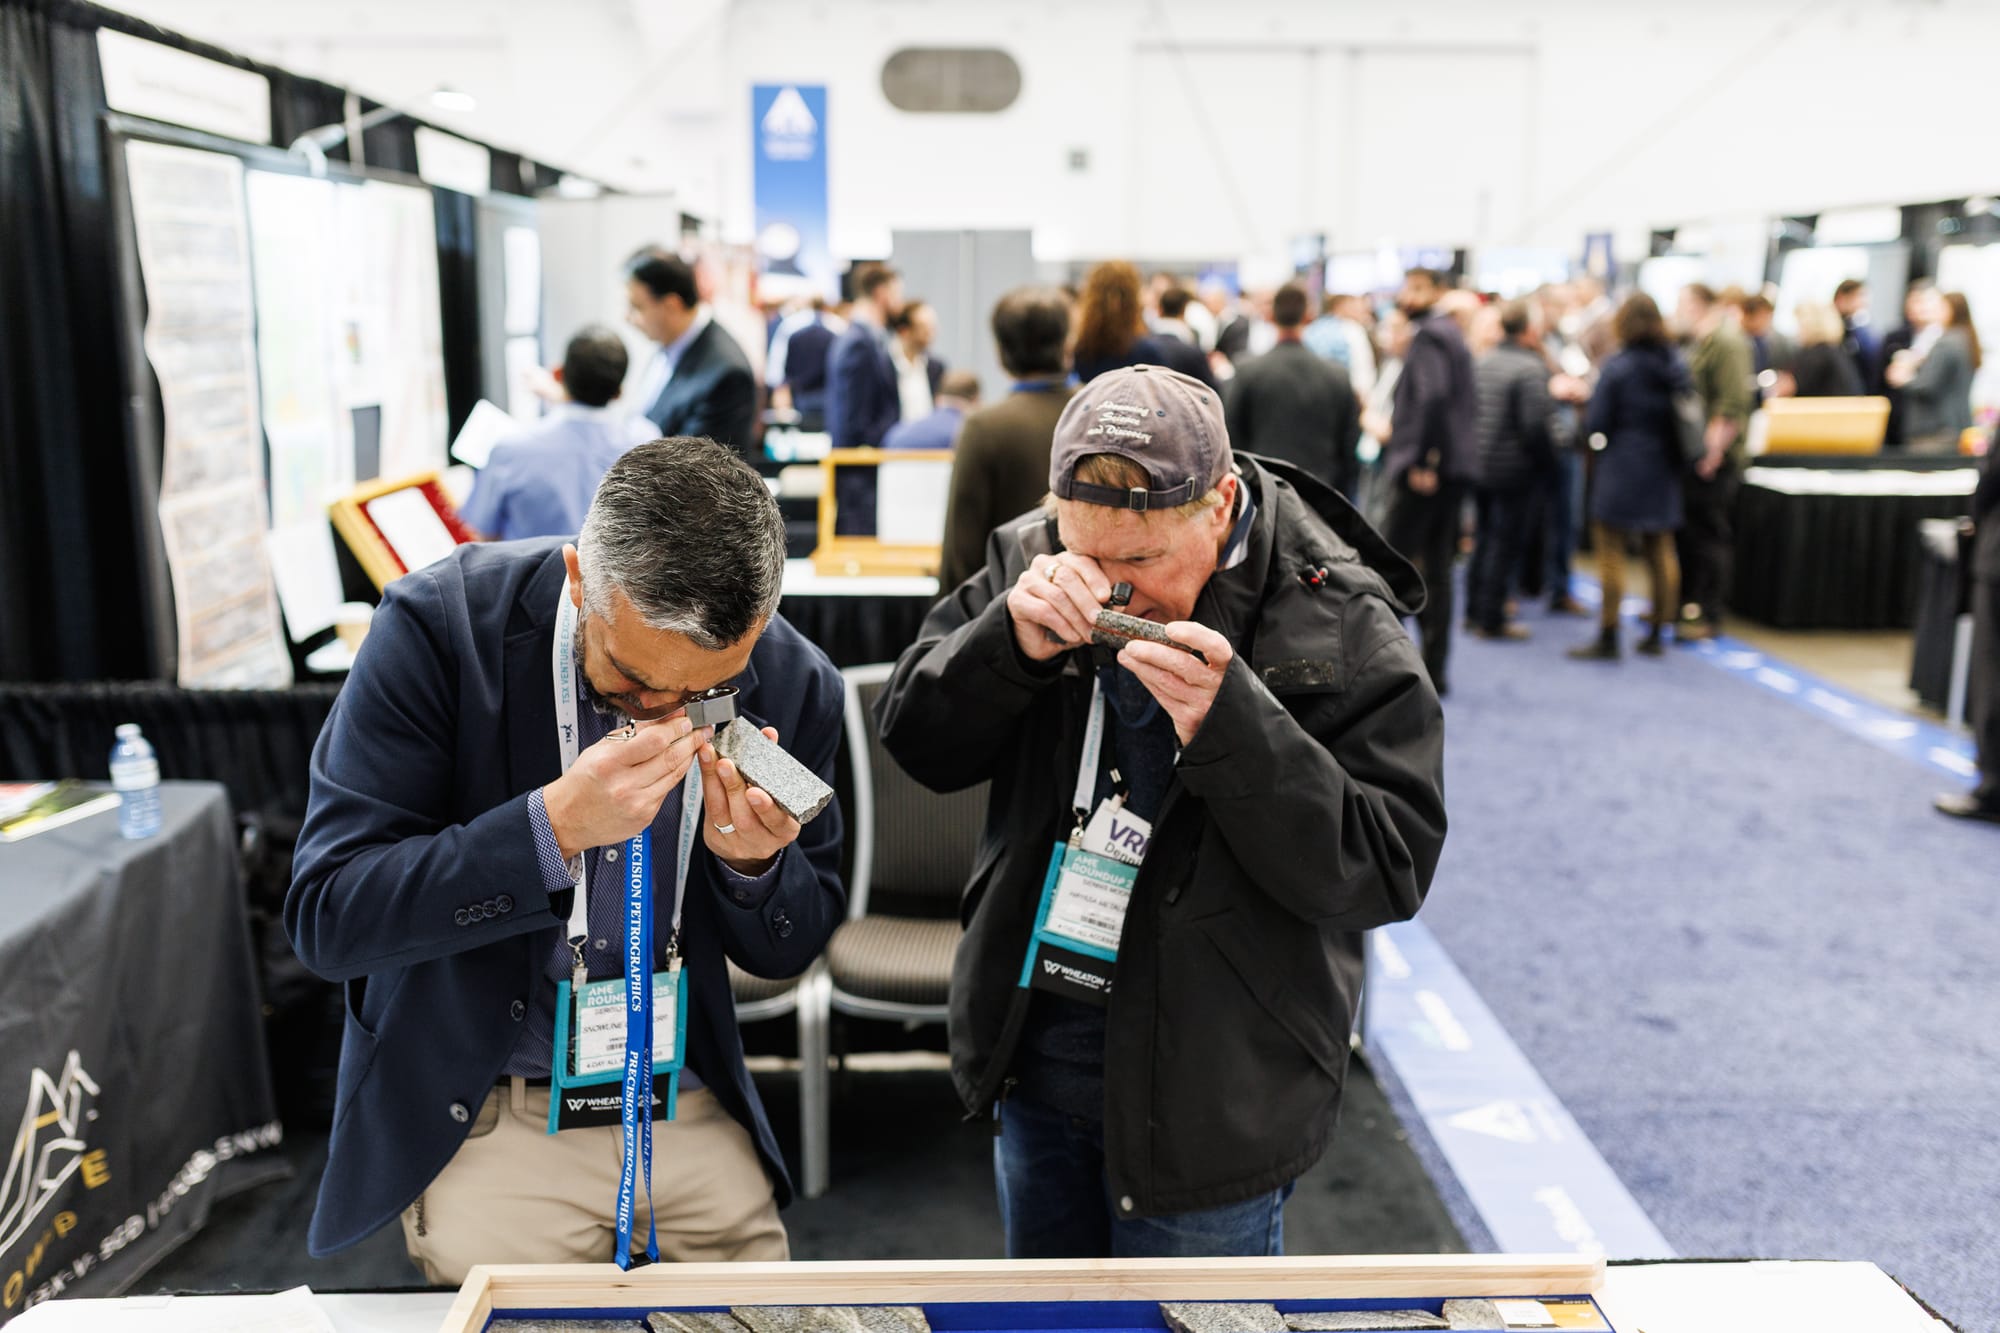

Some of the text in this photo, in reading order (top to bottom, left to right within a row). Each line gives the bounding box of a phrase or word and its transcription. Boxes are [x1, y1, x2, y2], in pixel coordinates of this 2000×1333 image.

[560, 642, 569, 685] VENTURE
[562, 688, 570, 704] TSX
[1071, 863, 1125, 885] ROUNDUP
[631, 832, 643, 1012] RECISION PETROGRAPHICS
[1060, 965, 1105, 985] WHEATON
[587, 992, 626, 1006] ROUND
[588, 984, 614, 996] AME
[587, 1096, 622, 1106] WHEAT
[617, 1051, 638, 1235] PRECISION PETROGRAPHICS
